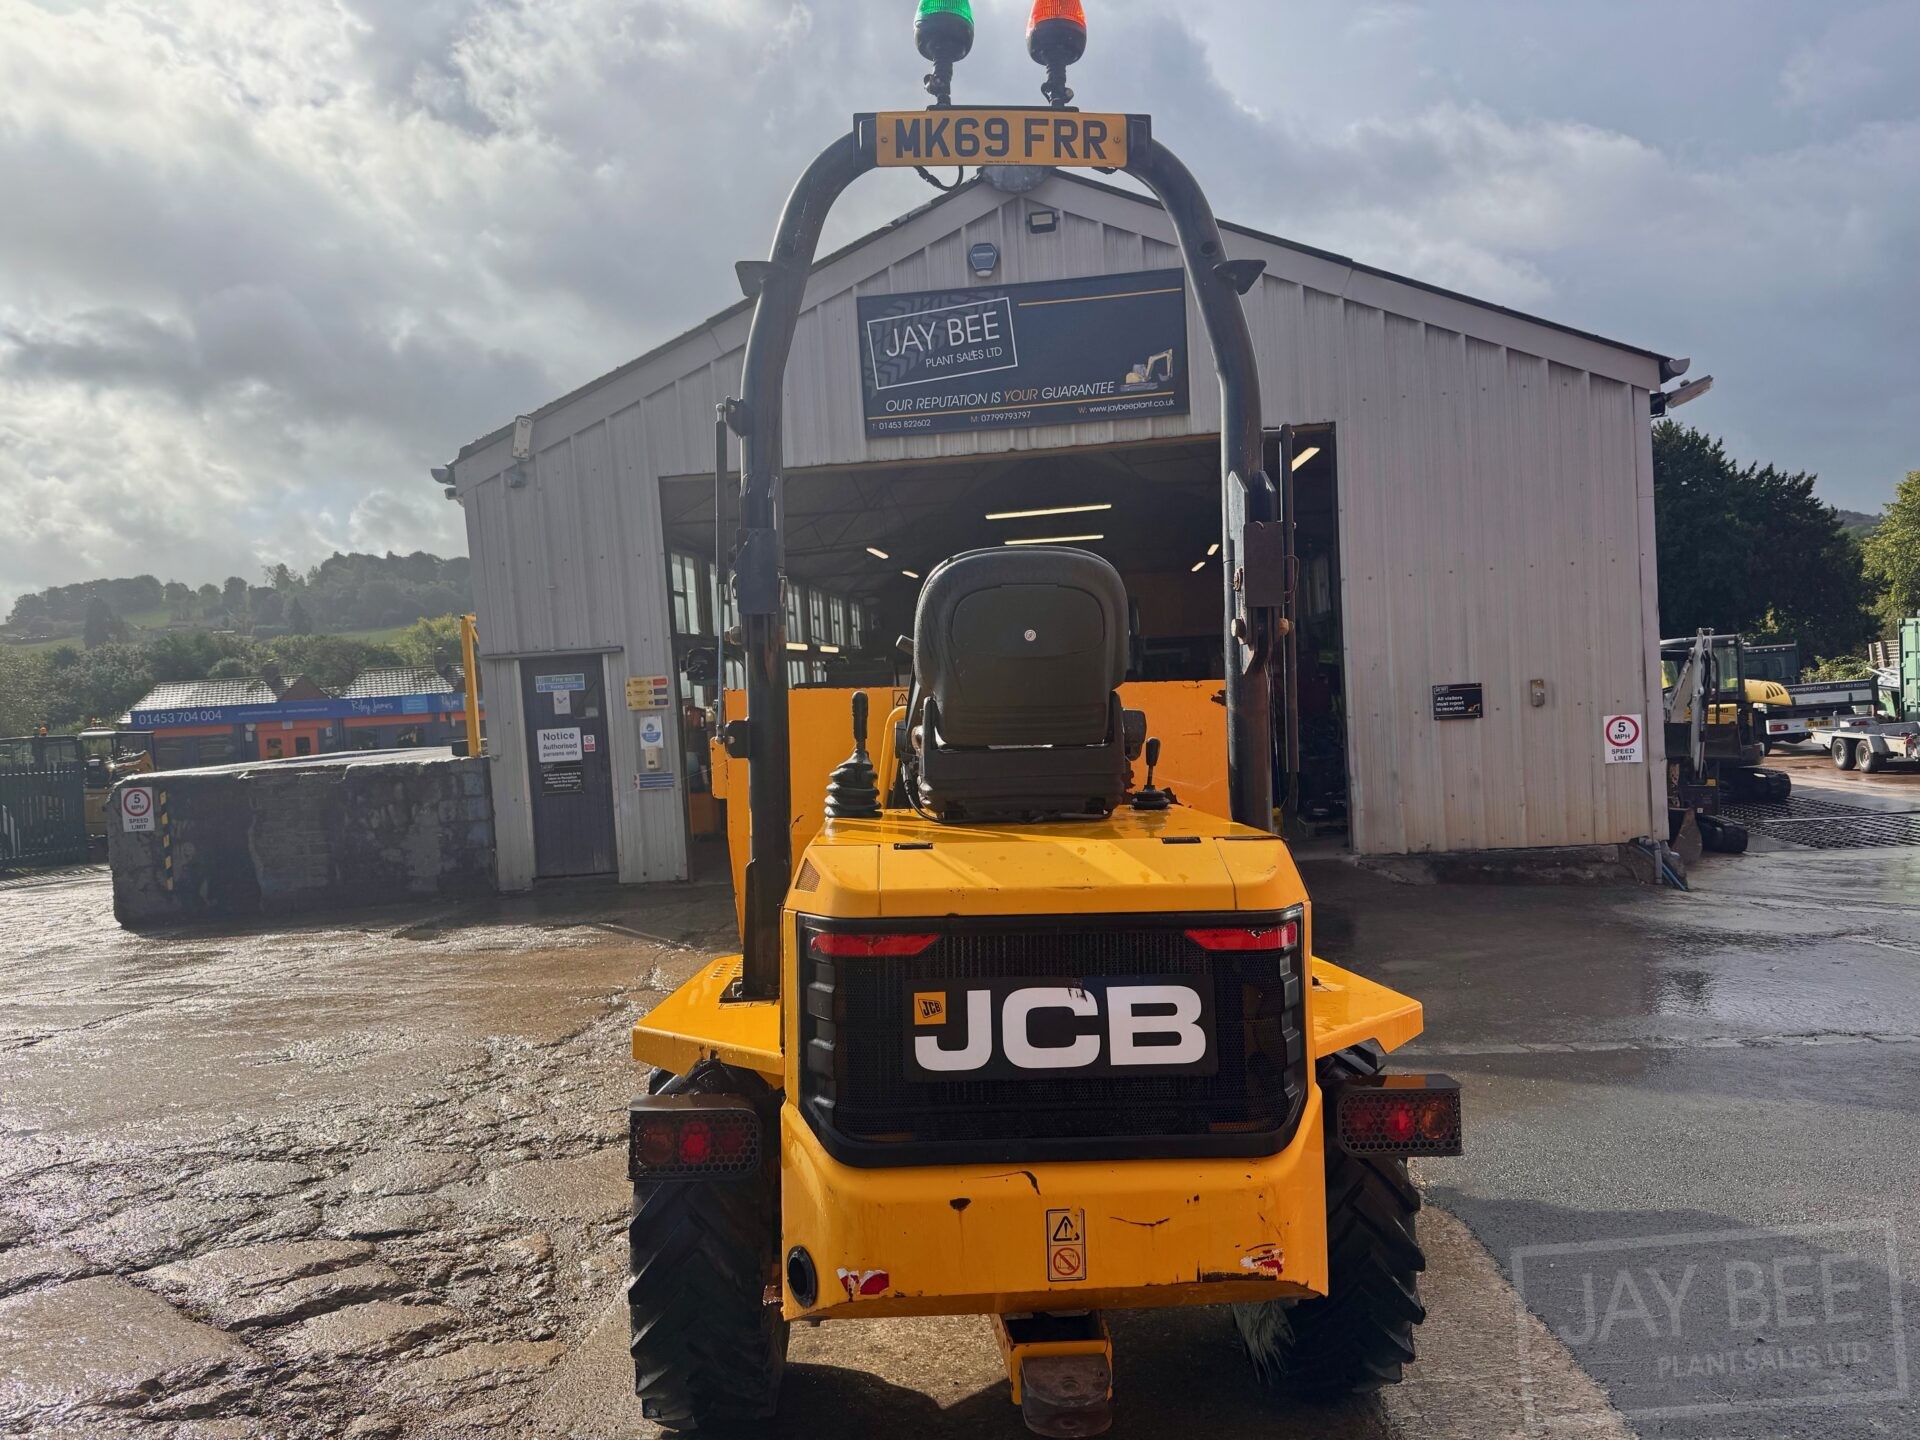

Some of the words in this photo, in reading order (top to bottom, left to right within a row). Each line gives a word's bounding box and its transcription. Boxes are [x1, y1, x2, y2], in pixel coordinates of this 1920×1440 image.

[895, 117, 1009, 158] MK69
[1024, 118, 1108, 160] FRR
[885, 321, 936, 357] JAY
[947, 311, 1000, 347] BEE
[925, 354, 954, 368] PLANT
[956, 349, 984, 363] SALES
[986, 346, 1003, 358] LTD
[885, 399, 913, 412] OUR
[916, 392, 987, 410] REPUTATION
[991, 391, 1001, 404] IS
[1004, 388, 1038, 403] YOUR
[1041, 381, 1115, 399] GUARANTEE
[1089, 398, 1175, 414] www.jaybeeplant.co.uk
[879, 421, 902, 430] 01453
[904, 419, 931, 429] 822602
[981, 410, 1031, 423] 07799793797
[138, 713, 175, 725] 01453
[176, 711, 198, 723] 704
[200, 709, 222, 721] 004
[1618, 721, 1626, 733] 5
[543, 732, 575, 741] Notice
[134, 794, 141, 804] 5
[922, 1000, 941, 1016] JCB
[914, 985, 1206, 1072] JCB
